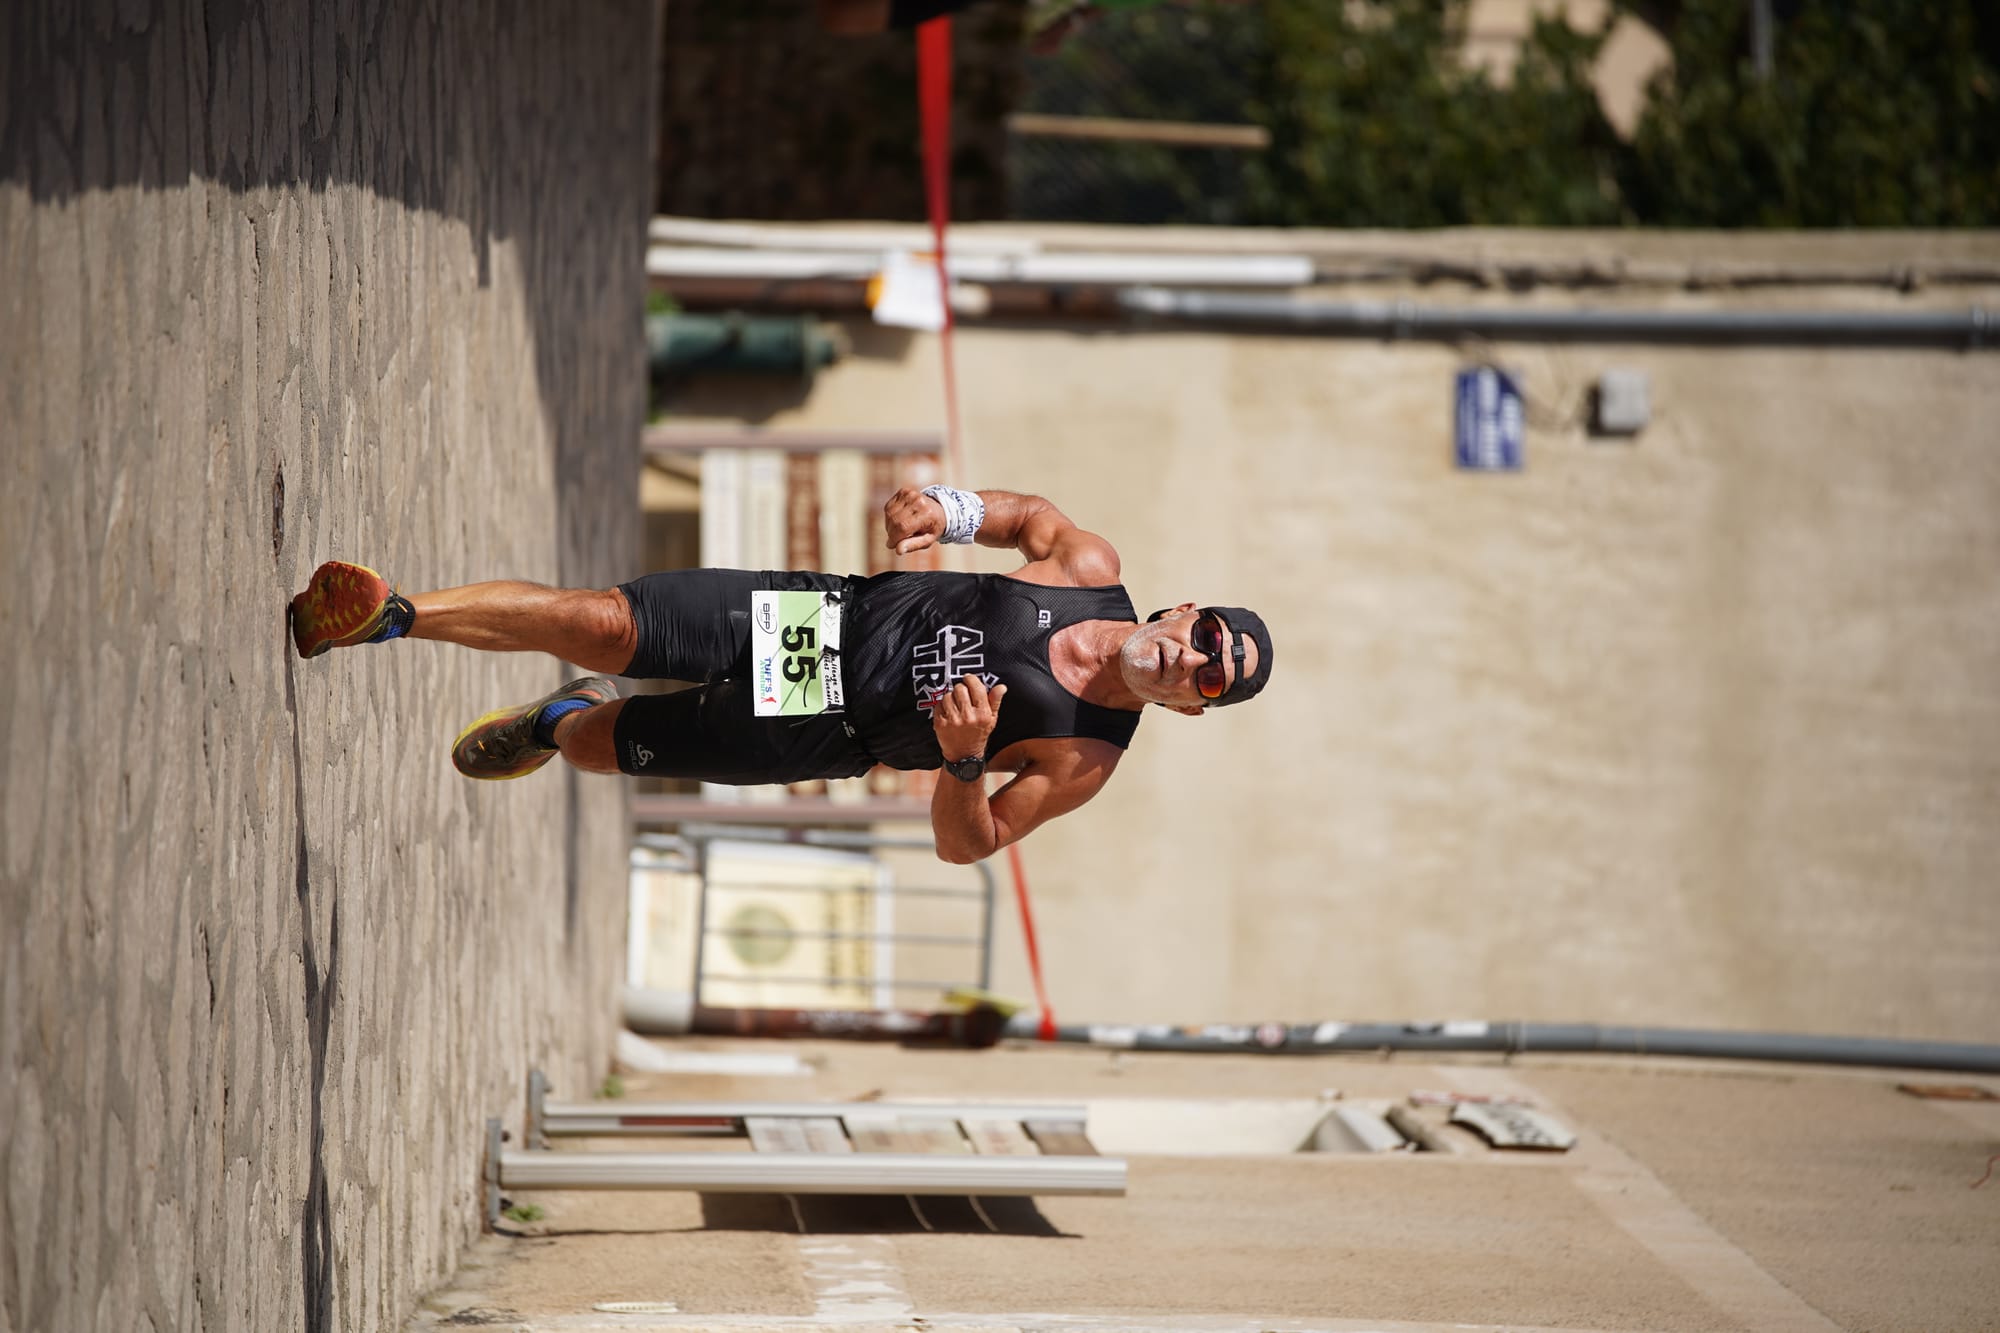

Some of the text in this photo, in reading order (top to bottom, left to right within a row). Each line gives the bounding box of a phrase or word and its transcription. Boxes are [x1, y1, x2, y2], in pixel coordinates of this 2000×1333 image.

[762, 602, 771, 630] BFP
[781, 624, 817, 683] 55
[763, 656, 773, 693] TUFF'S
